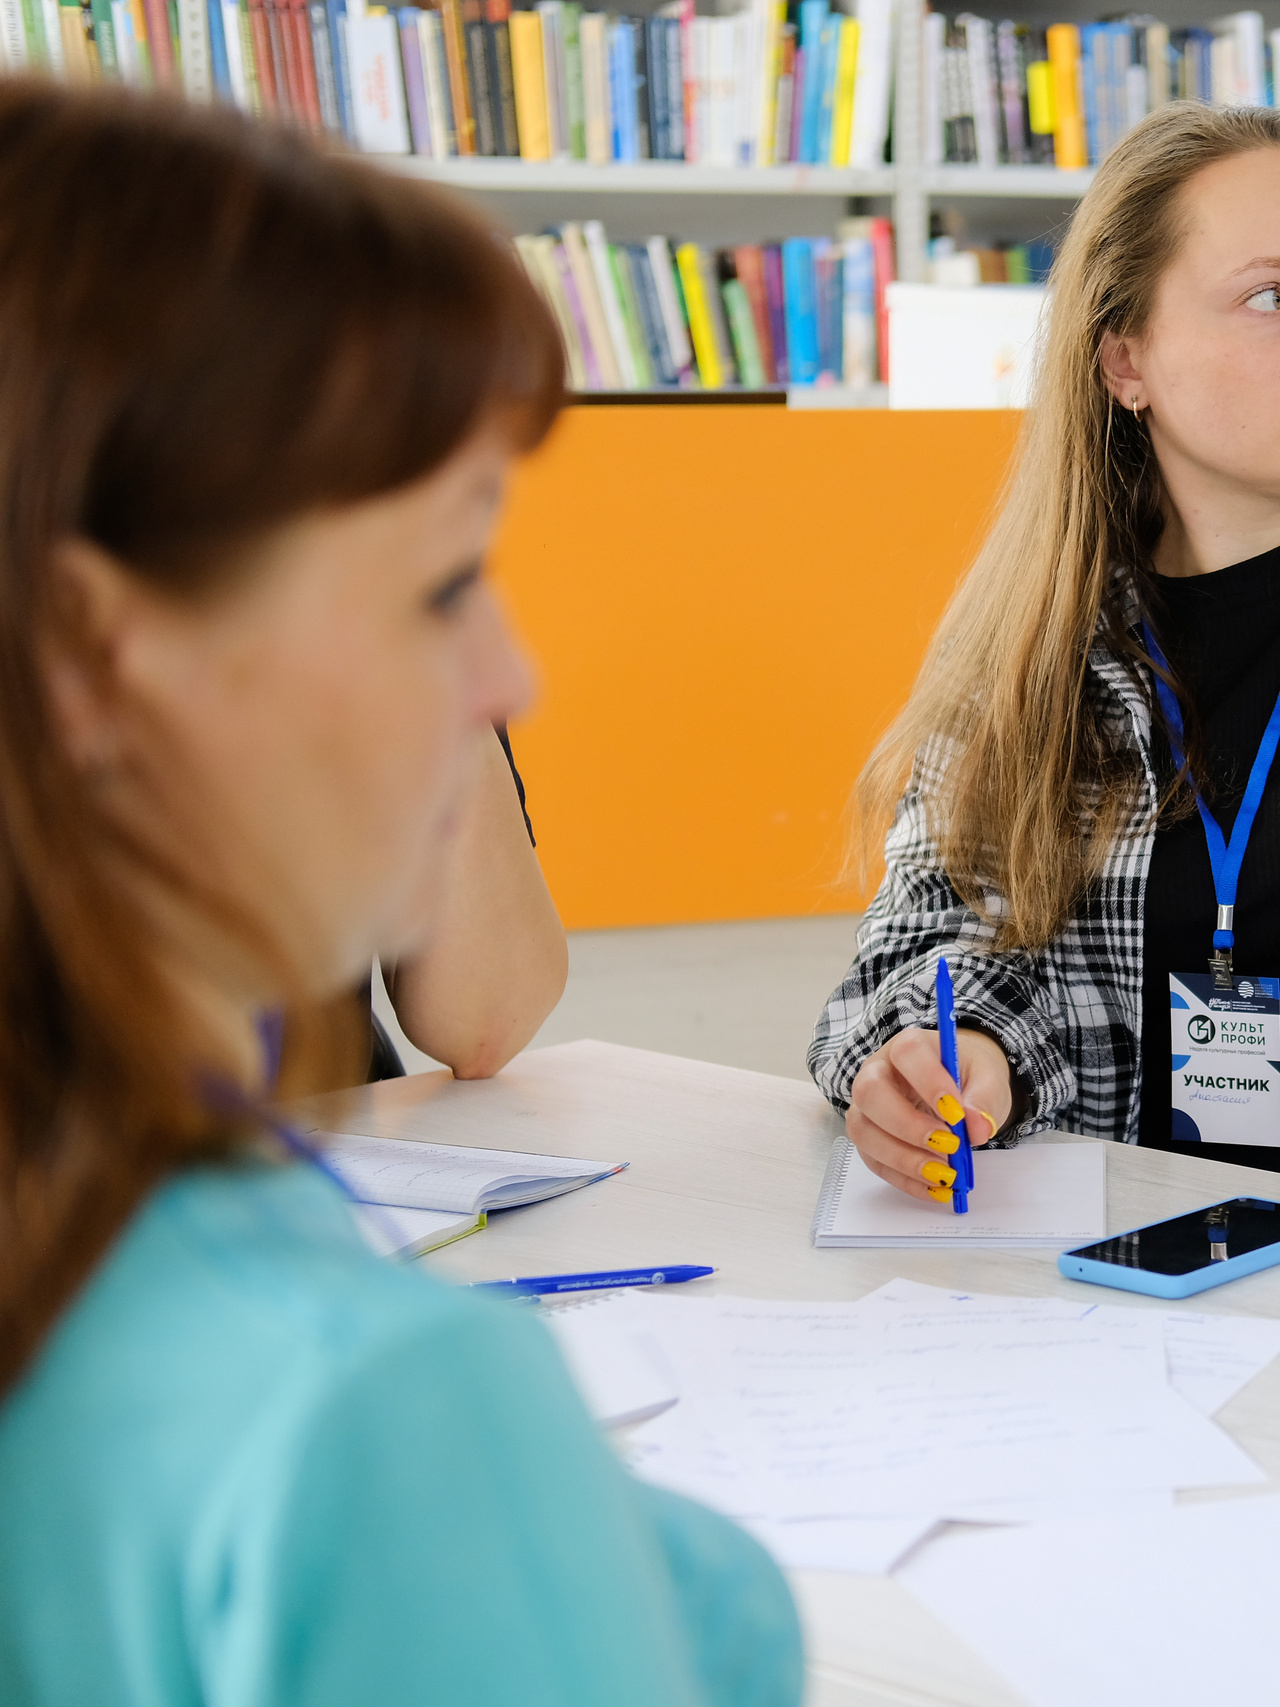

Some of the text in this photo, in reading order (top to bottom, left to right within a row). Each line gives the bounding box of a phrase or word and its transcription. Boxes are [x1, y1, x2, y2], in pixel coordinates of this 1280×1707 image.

[1220, 1021, 1265, 1034] КУЛЬТ
[1221, 1034, 1266, 1046] ПРОФИ
[1183, 1074, 1270, 1092] УЧАСТНИК
